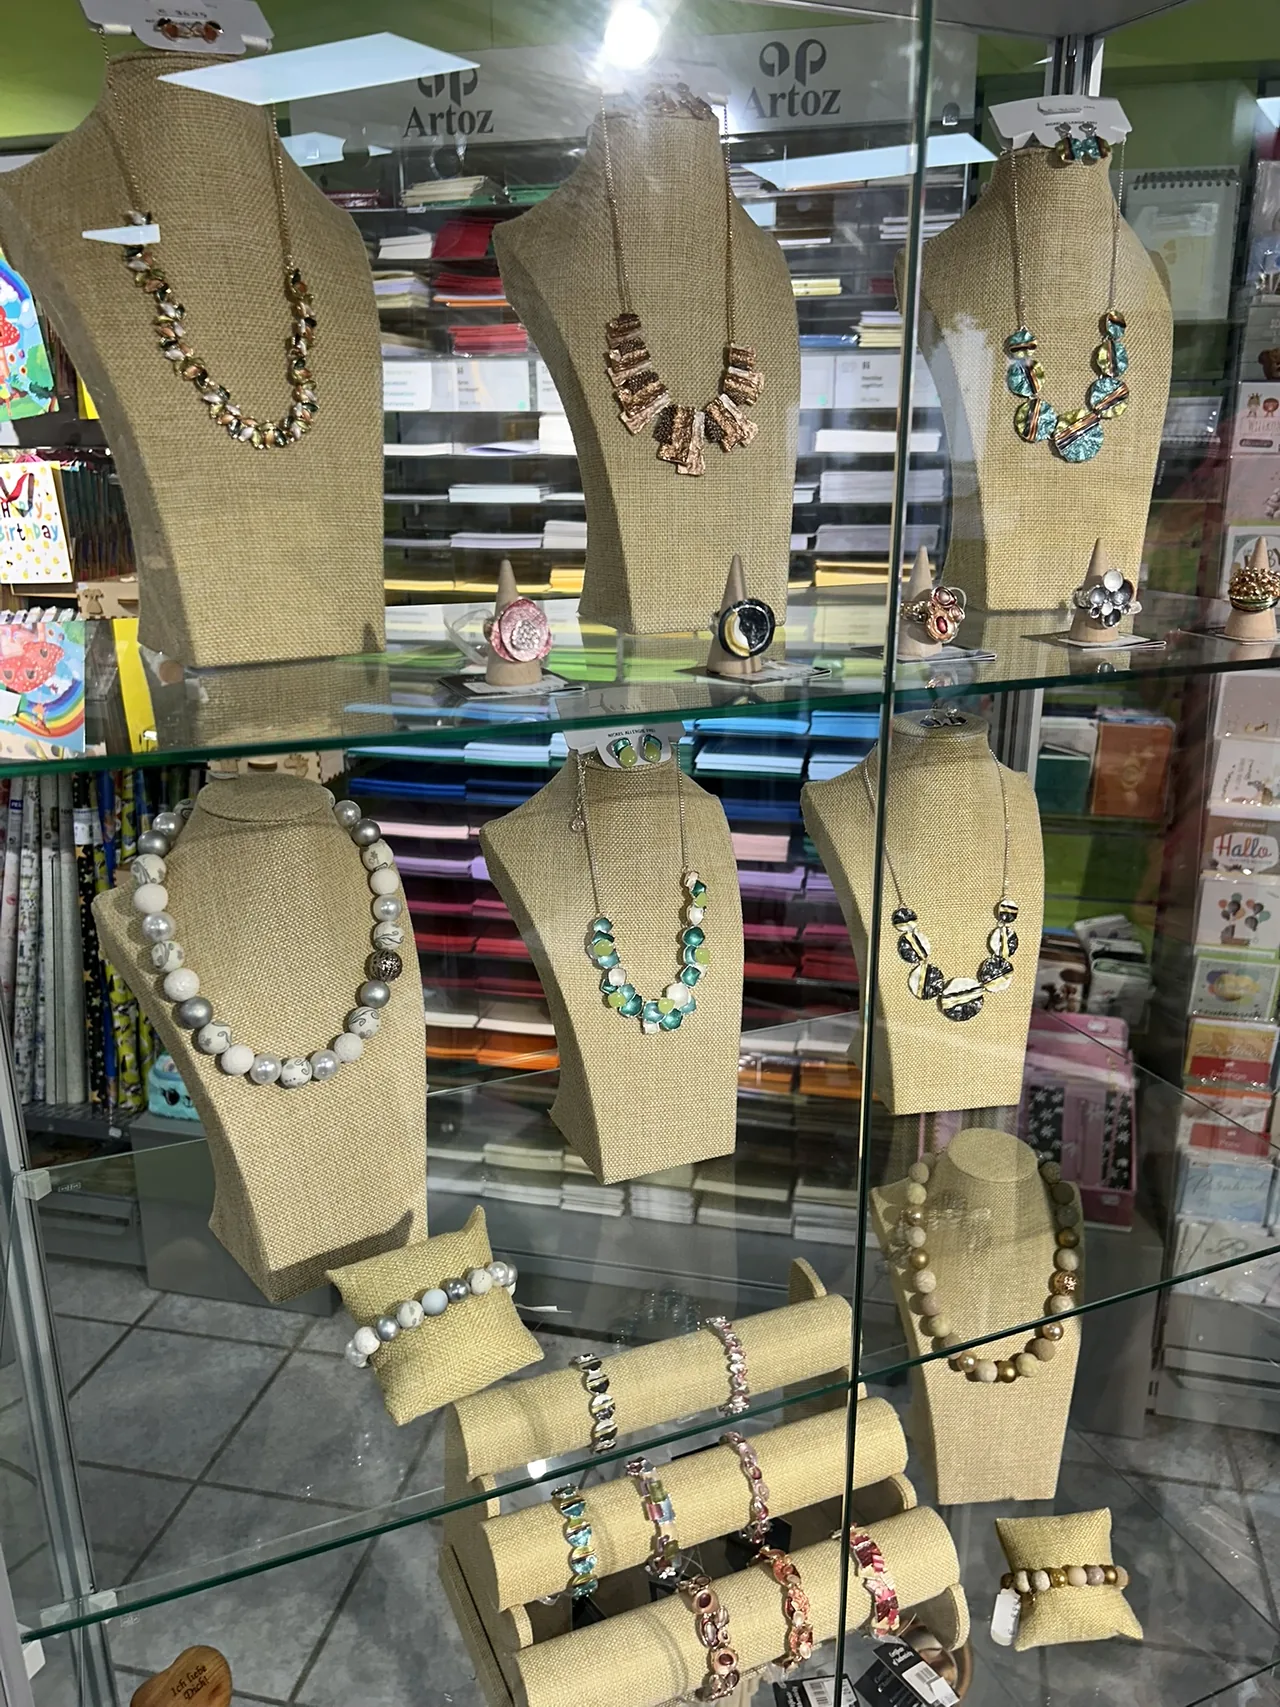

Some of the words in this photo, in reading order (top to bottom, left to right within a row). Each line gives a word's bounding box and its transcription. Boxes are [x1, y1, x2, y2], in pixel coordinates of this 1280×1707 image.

[742, 83, 842, 120] Artoz
[402, 103, 495, 138] Artoz
[1216, 834, 1273, 860] Hallo
[171, 1678, 187, 1697] Ich
[186, 1665, 207, 1683] liebe
[183, 1675, 210, 1700] Dich!
